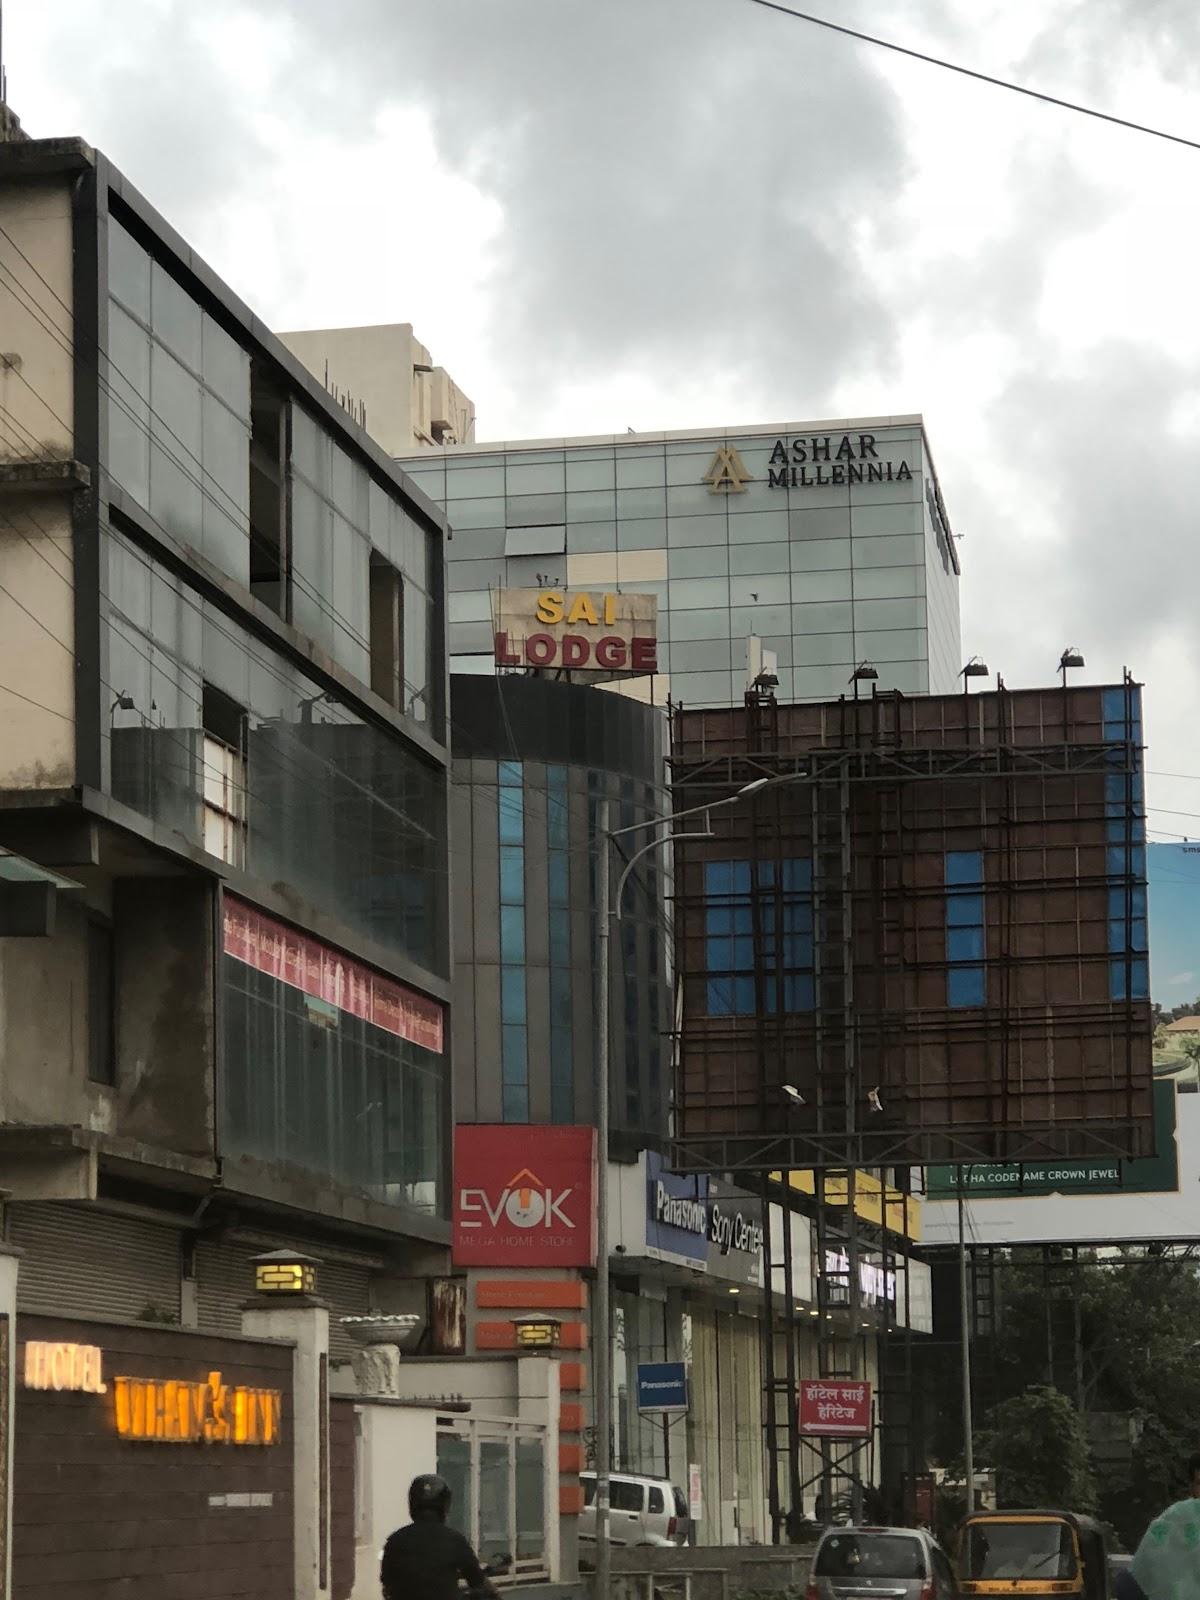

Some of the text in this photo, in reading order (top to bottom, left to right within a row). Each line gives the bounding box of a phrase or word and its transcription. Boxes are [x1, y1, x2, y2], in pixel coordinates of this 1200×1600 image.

[768, 434, 879, 464] ASHAR
[768, 460, 913, 488] MILLENNIA
[536, 591, 616, 625] SAI
[495, 632, 658, 669] LODGE
[1048, 1170, 1086, 1180] CROWN
[1089, 1168, 1120, 1180] JEWEL
[460, 1187, 576, 1228] EVOK
[657, 1180, 707, 1234] Panasonic
[500, 1235, 534, 1247] HOME
[711, 1204, 735, 1255] Sony
[25, 1341, 107, 1394] HOTEL
[806, 1384, 865, 1403] हॉटेल साई
[817, 1402, 857, 1420] हेरिटेज
